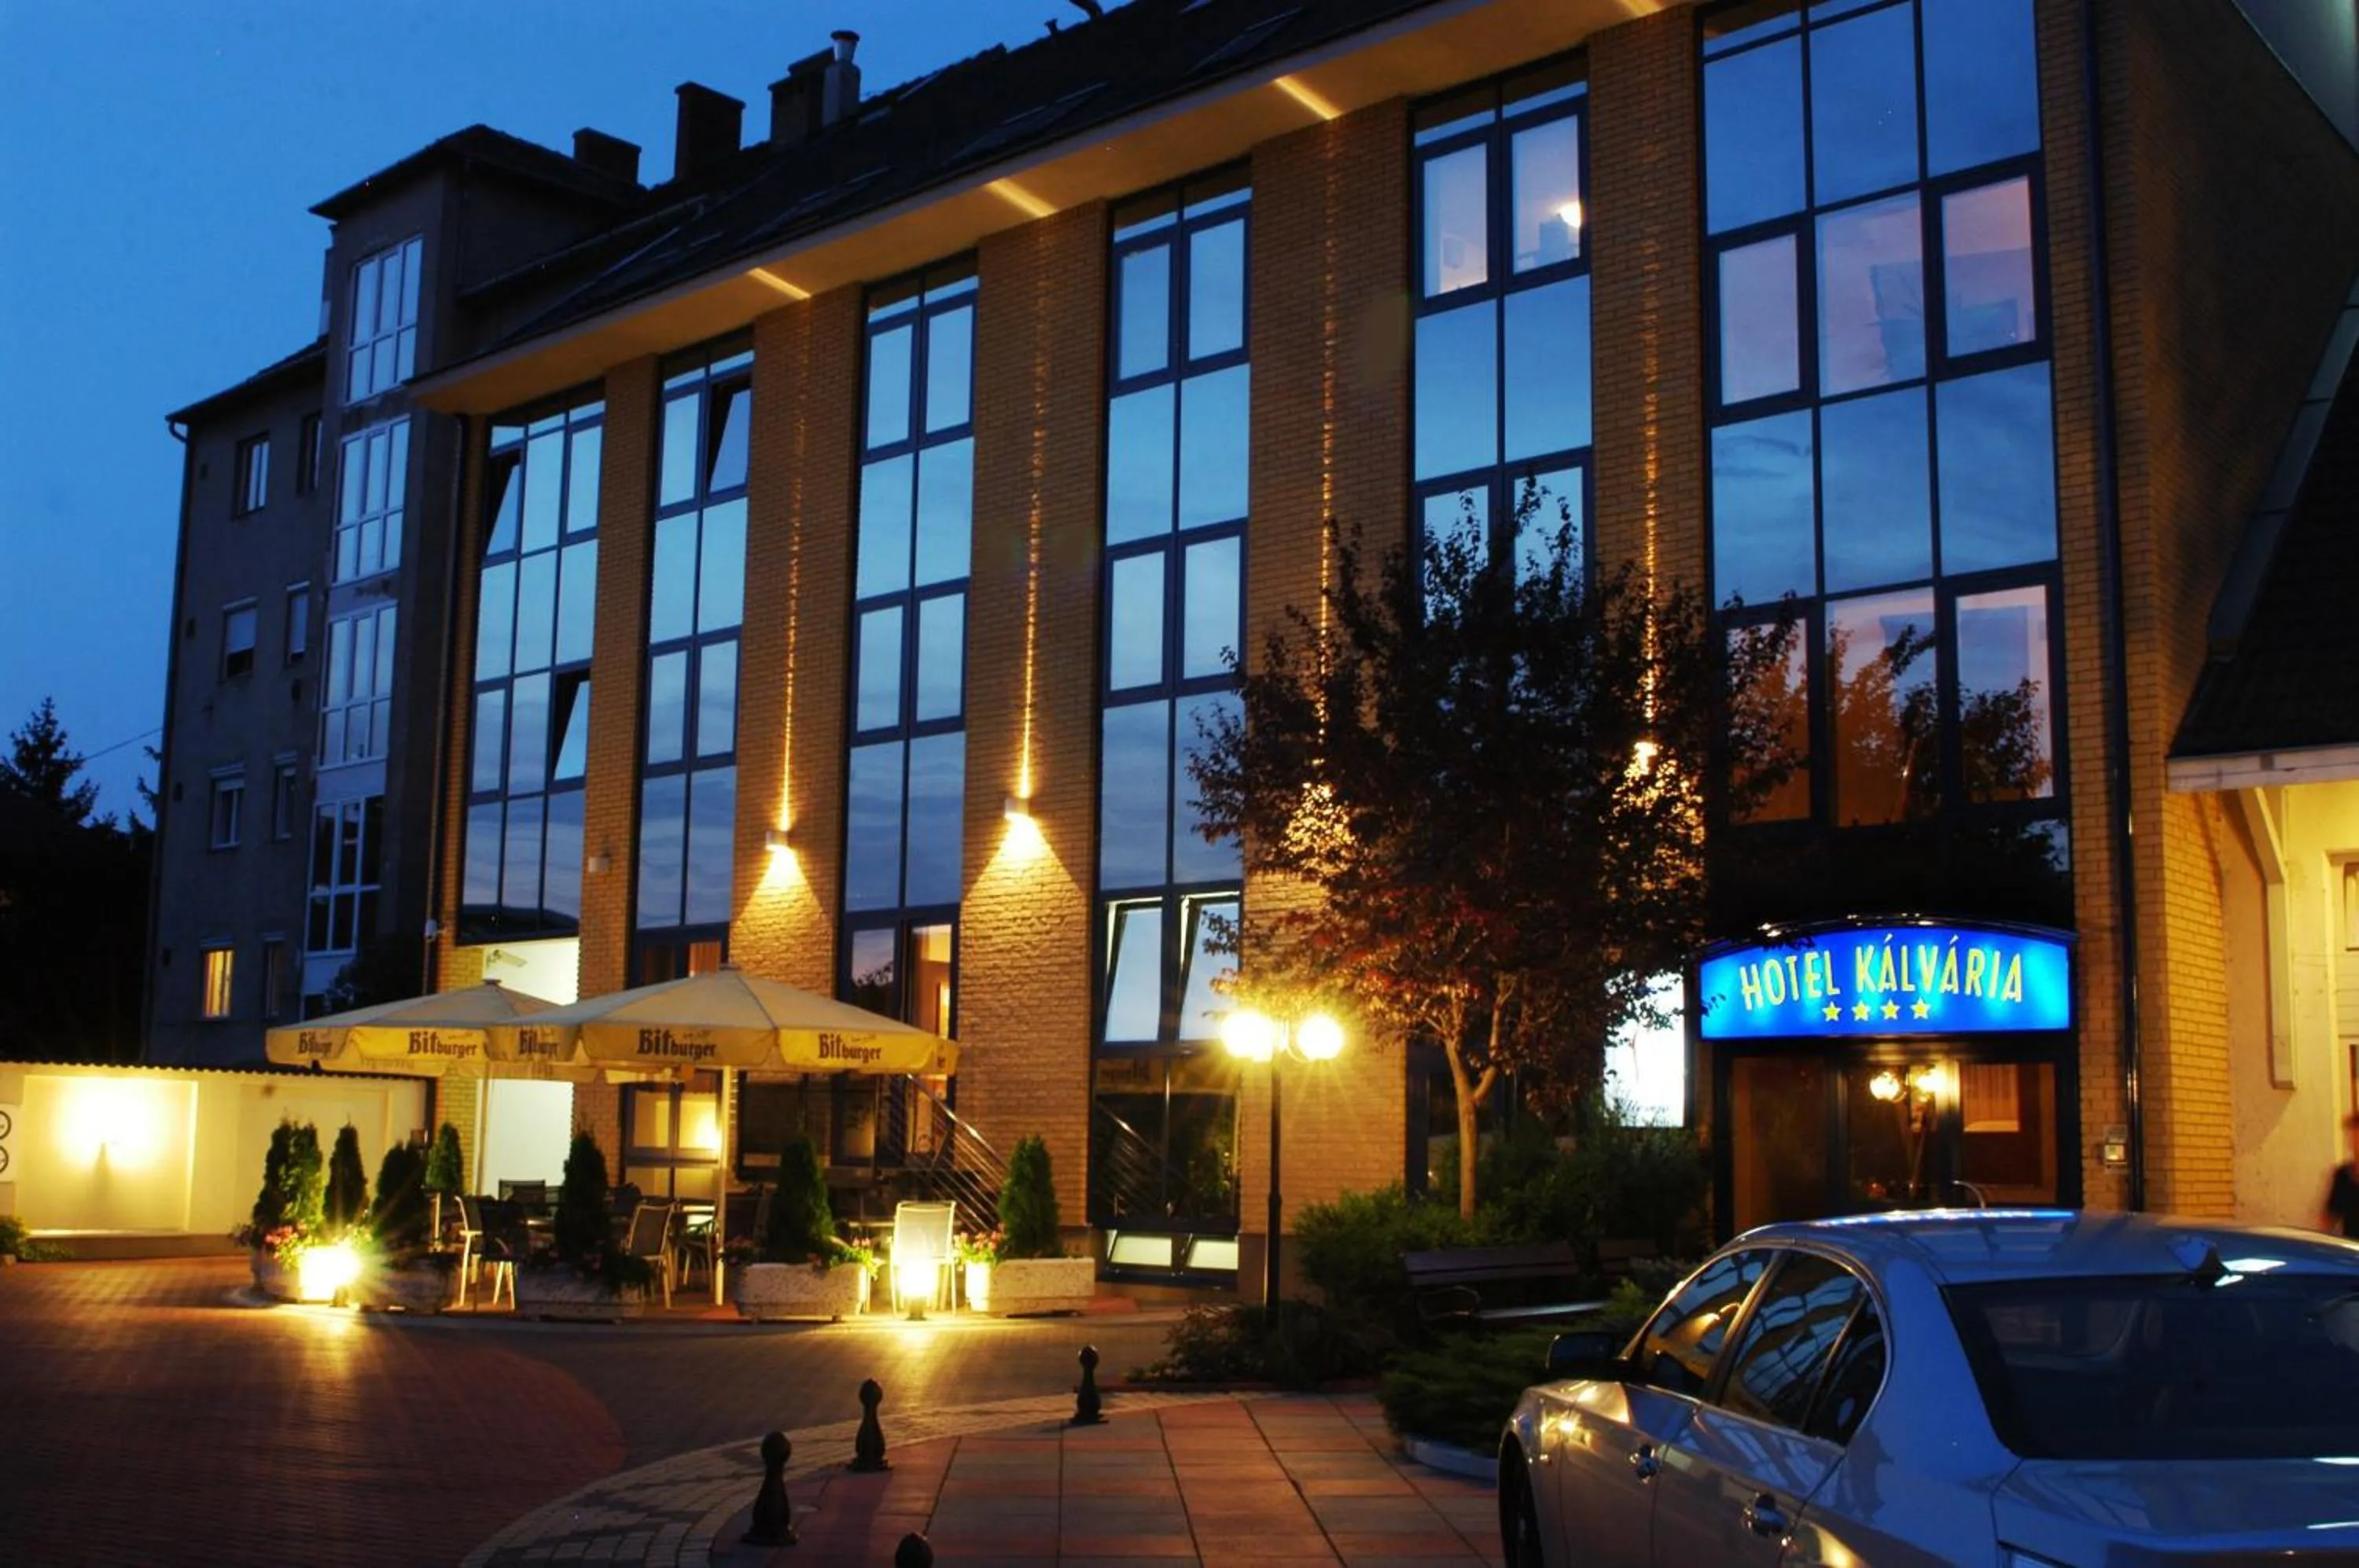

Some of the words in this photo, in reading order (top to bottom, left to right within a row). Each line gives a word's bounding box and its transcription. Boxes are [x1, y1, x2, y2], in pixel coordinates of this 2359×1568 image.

[1740, 950, 1841, 1011] HOTEL
[1856, 934, 2022, 1003] KÁLVÁRIA
[408, 1031, 477, 1059] Bitburger
[637, 1029, 717, 1061] Bitburger
[818, 1032, 881, 1064] Bitburger
